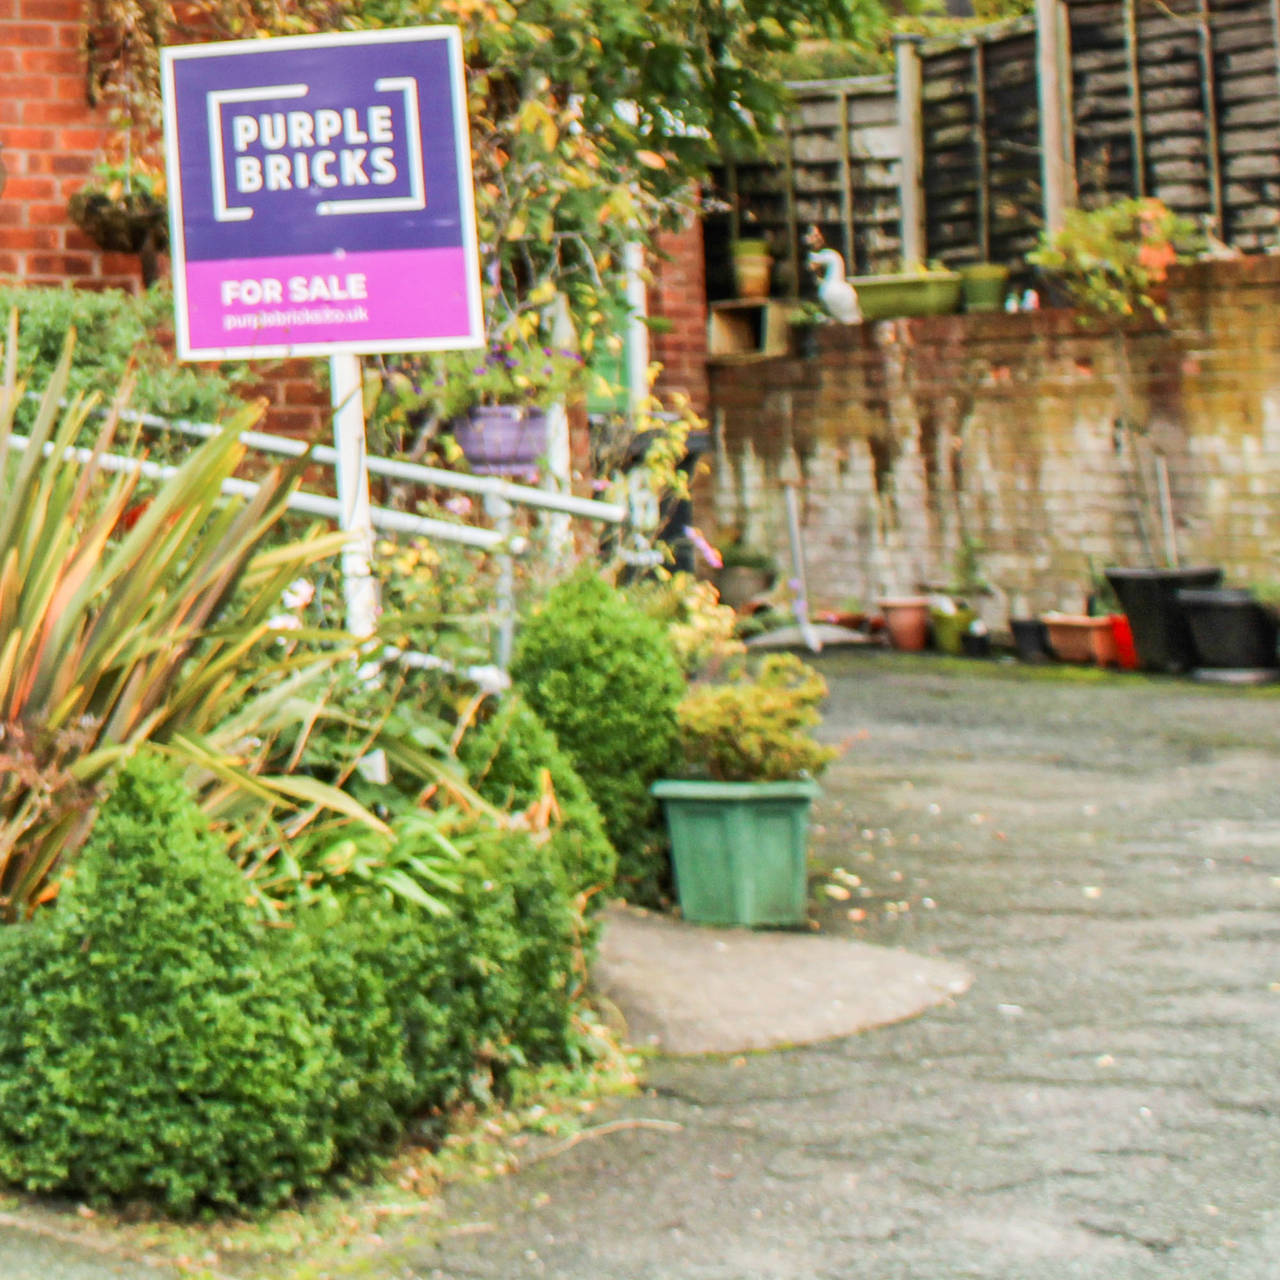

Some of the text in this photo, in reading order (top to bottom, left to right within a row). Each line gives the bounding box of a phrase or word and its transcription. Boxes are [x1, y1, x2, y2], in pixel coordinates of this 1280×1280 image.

[233, 106, 394, 152] PURPLE
[235, 147, 397, 193] BRICKS
[221, 273, 368, 306] FOR SALE
